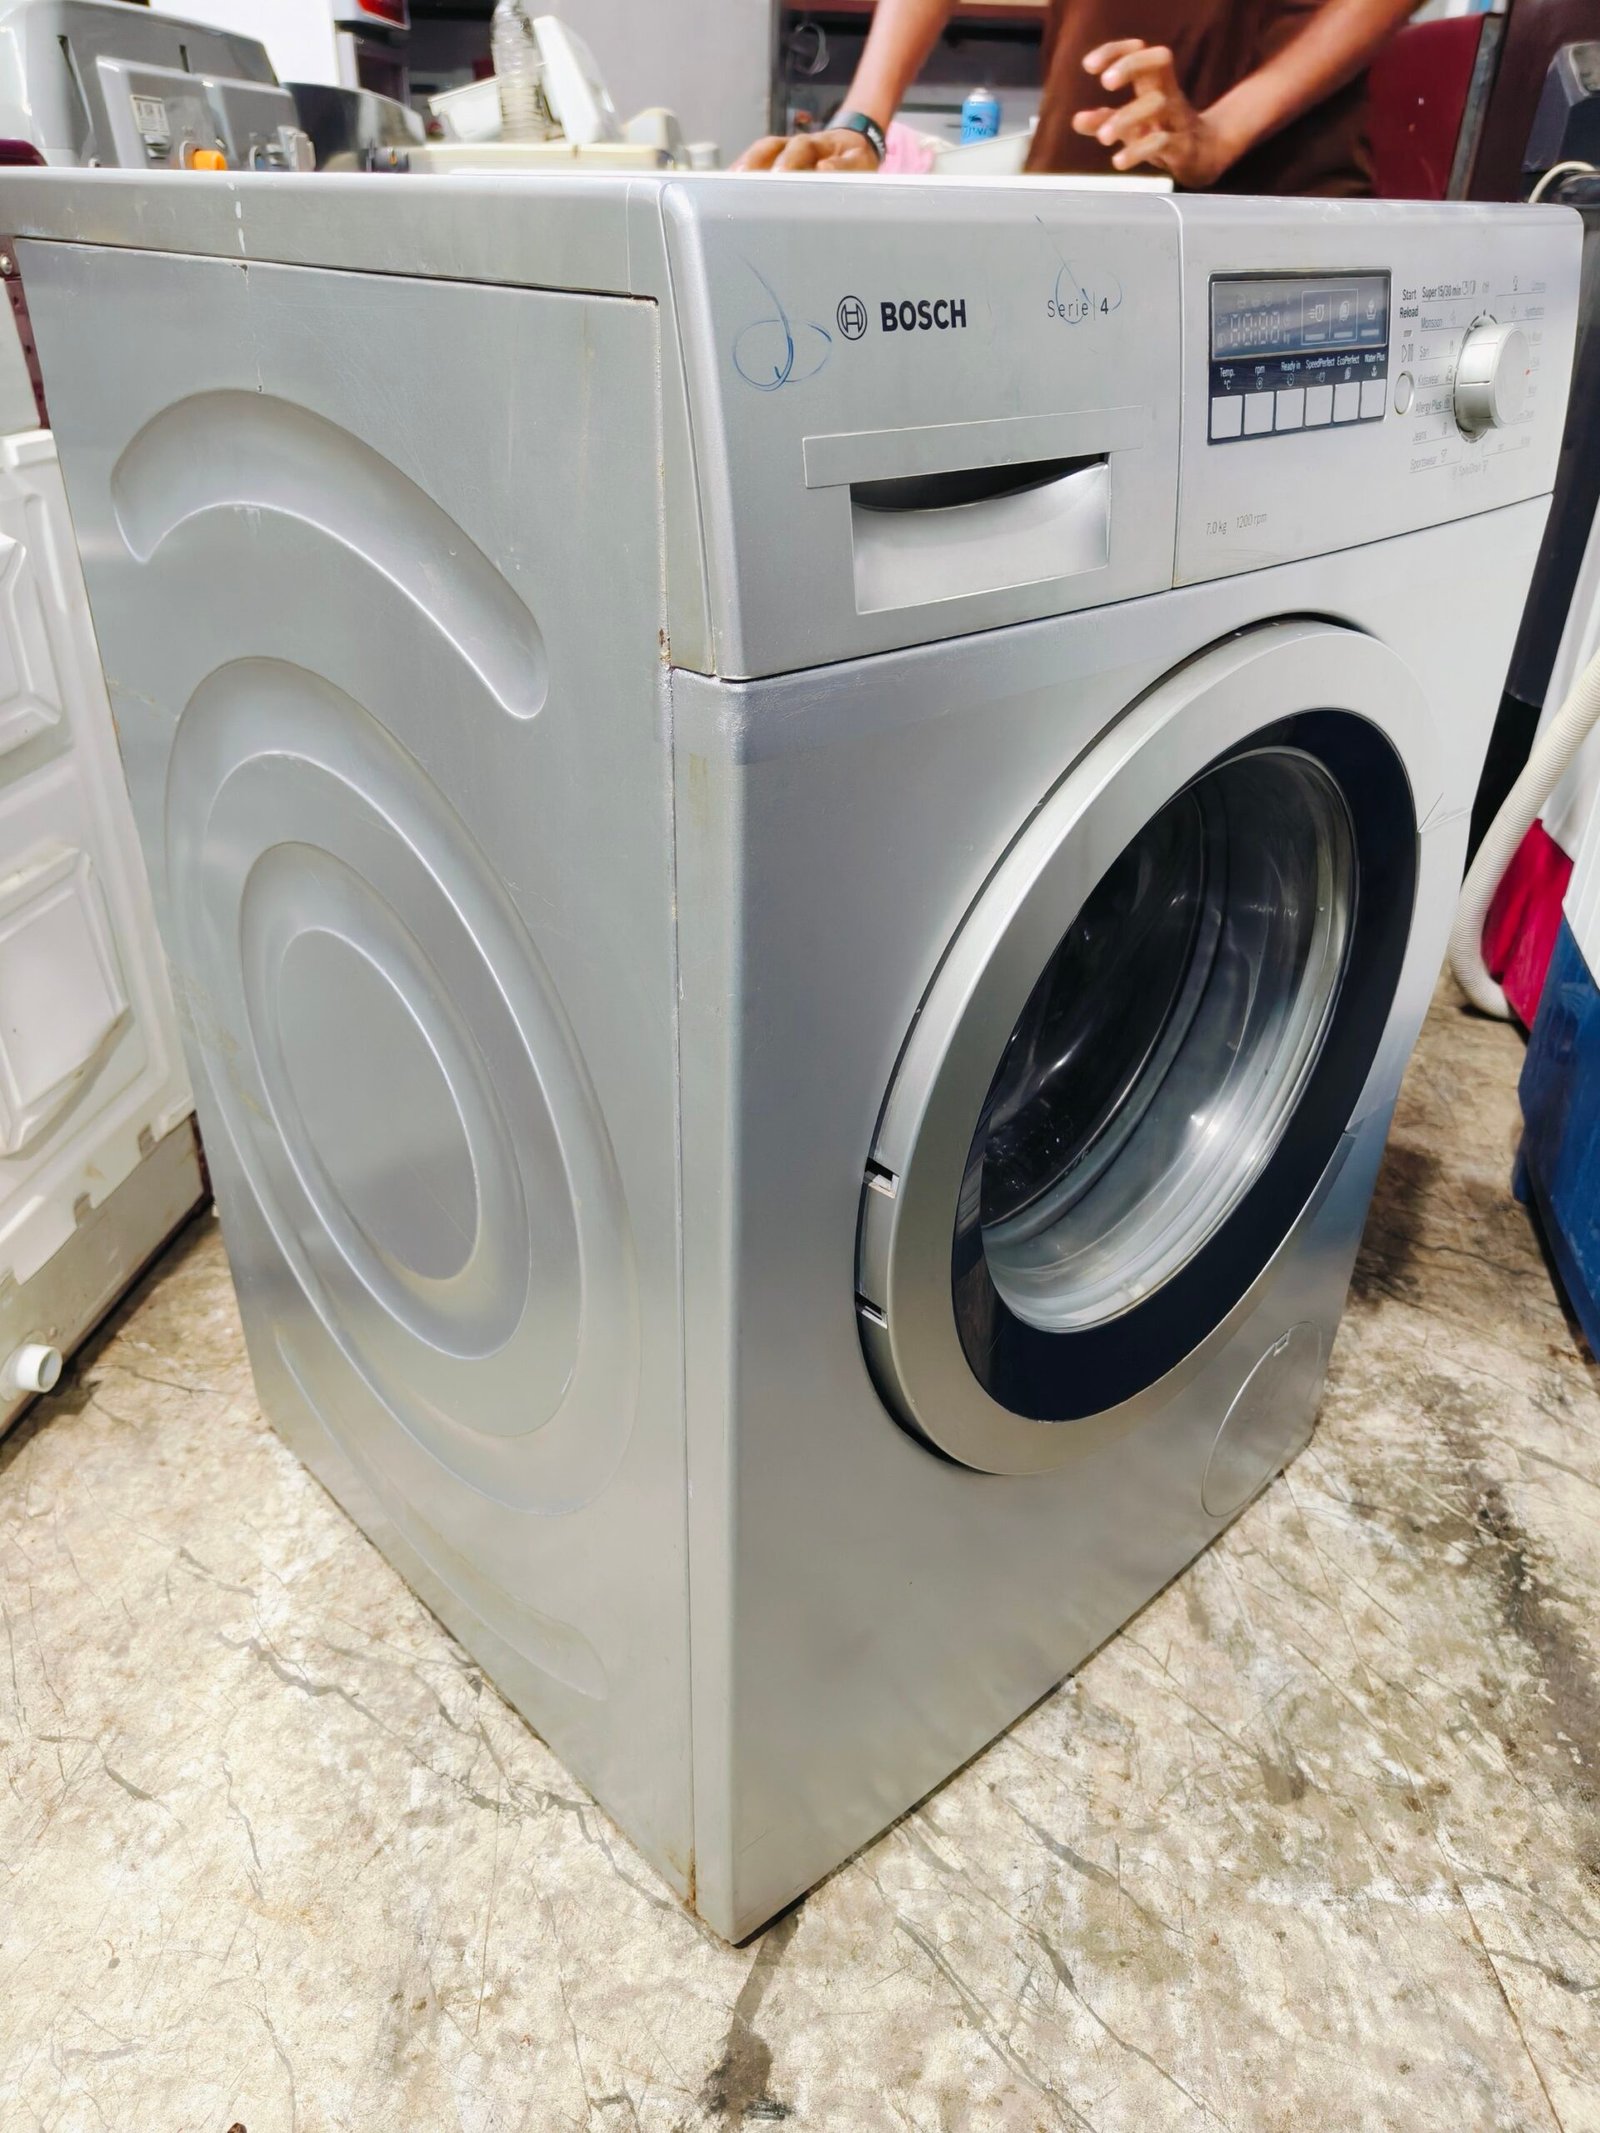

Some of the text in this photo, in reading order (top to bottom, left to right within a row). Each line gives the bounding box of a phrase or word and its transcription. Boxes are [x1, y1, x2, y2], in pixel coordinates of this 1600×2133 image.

[1402, 288, 1417, 301] Start
[1422, 286, 1438, 300] Super
[1047, 297, 1109, 318] Serie 4
[1400, 305, 1419, 319] Reload
[880, 299, 966, 332] BOSCH
[1305, 356, 1336, 370] SpeedPerfect
[1336, 354, 1360, 366] EcoPerfect
[1376, 352, 1386, 362] Plus
[1219, 367, 1236, 379] Temp.
[1254, 365, 1266, 377] rpm
[1280, 360, 1301, 373] Ready in
[1206, 513, 1268, 536] 7.0 kg 1200 rpm
